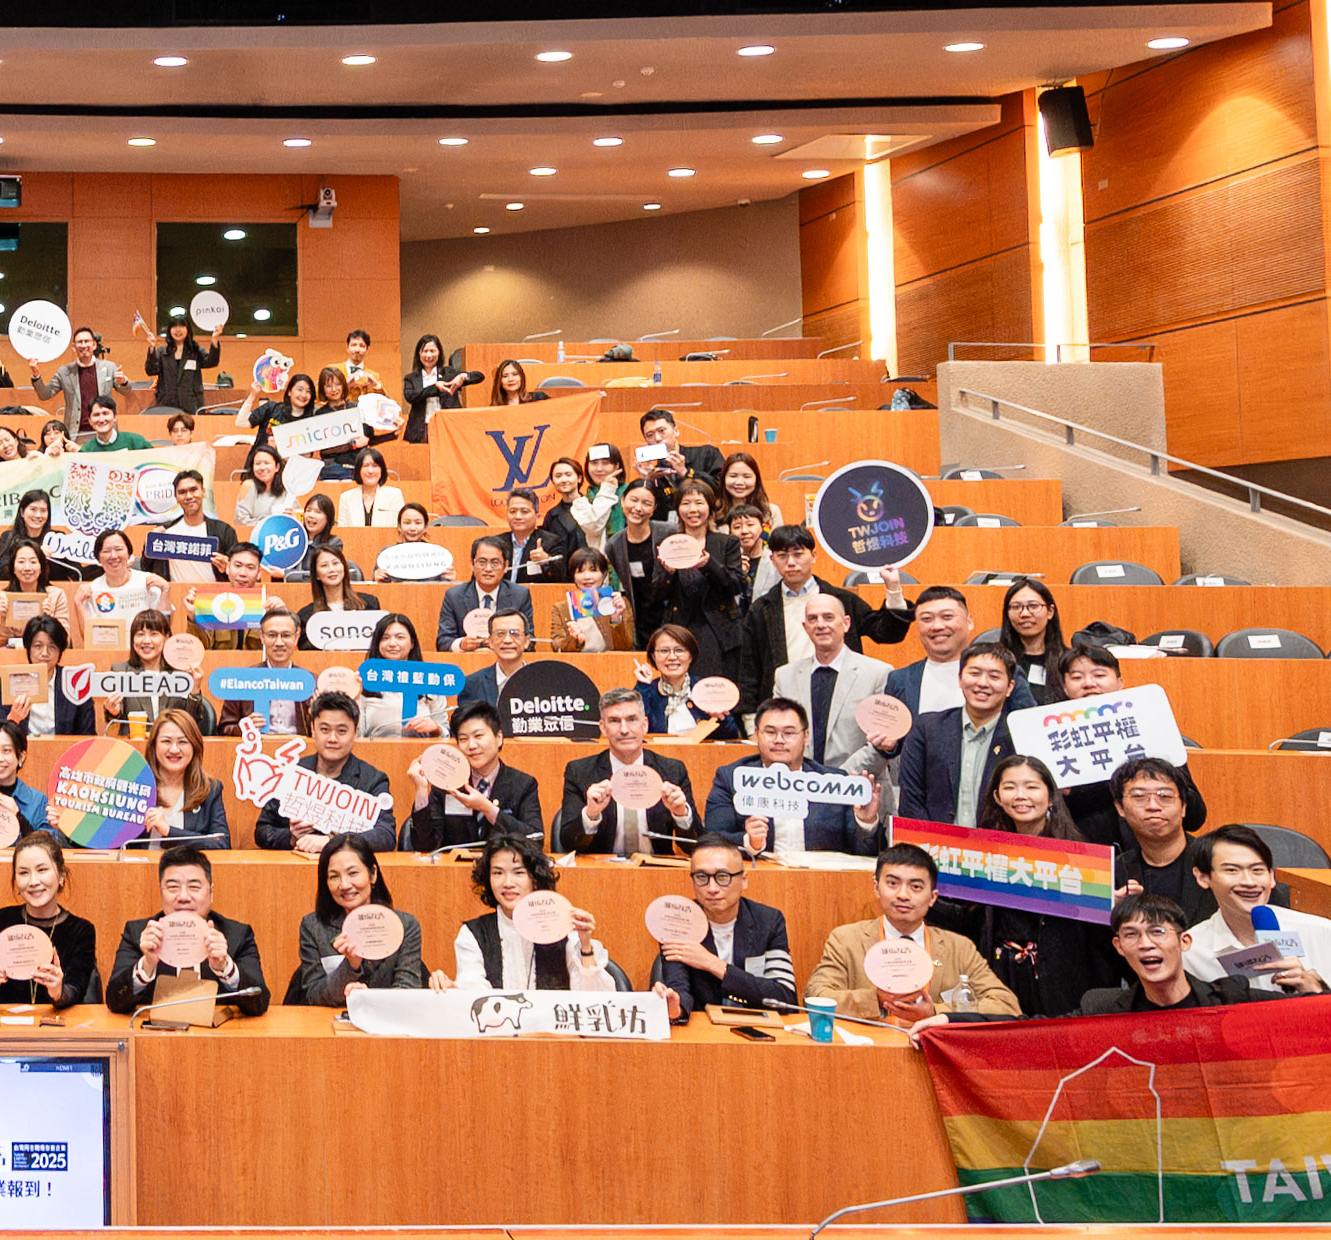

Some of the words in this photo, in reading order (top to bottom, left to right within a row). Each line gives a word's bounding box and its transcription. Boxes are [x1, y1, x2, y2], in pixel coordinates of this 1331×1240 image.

[196, 306, 225, 317] pinkoi
[286, 421, 357, 449] micron
[146, 488, 173, 500] PRID
[264, 527, 299, 553] P&G
[848, 517, 905, 539] TWJOIN
[47, 536, 95, 560] Unile
[152, 538, 213, 557] 台灣賽諾菲
[320, 625, 373, 640] sano
[101, 675, 190, 695] GILEAD
[220, 678, 304, 691] #ElancoTaiwan
[1047, 716, 1141, 752] 彩虹平權
[59, 766, 152, 798] 高雄市政府觀光局
[742, 772, 864, 797] webcomm
[56, 780, 148, 813] KAOHSIUNG
[295, 770, 377, 821] TWJOIN
[742, 795, 800, 812] 偉康科技
[54, 796, 100, 814] TOURISM
[101, 807, 145, 825] BUREAU
[554, 1003, 647, 1035] 鮮乳坊
[30, 1152, 66, 1168] 2025
